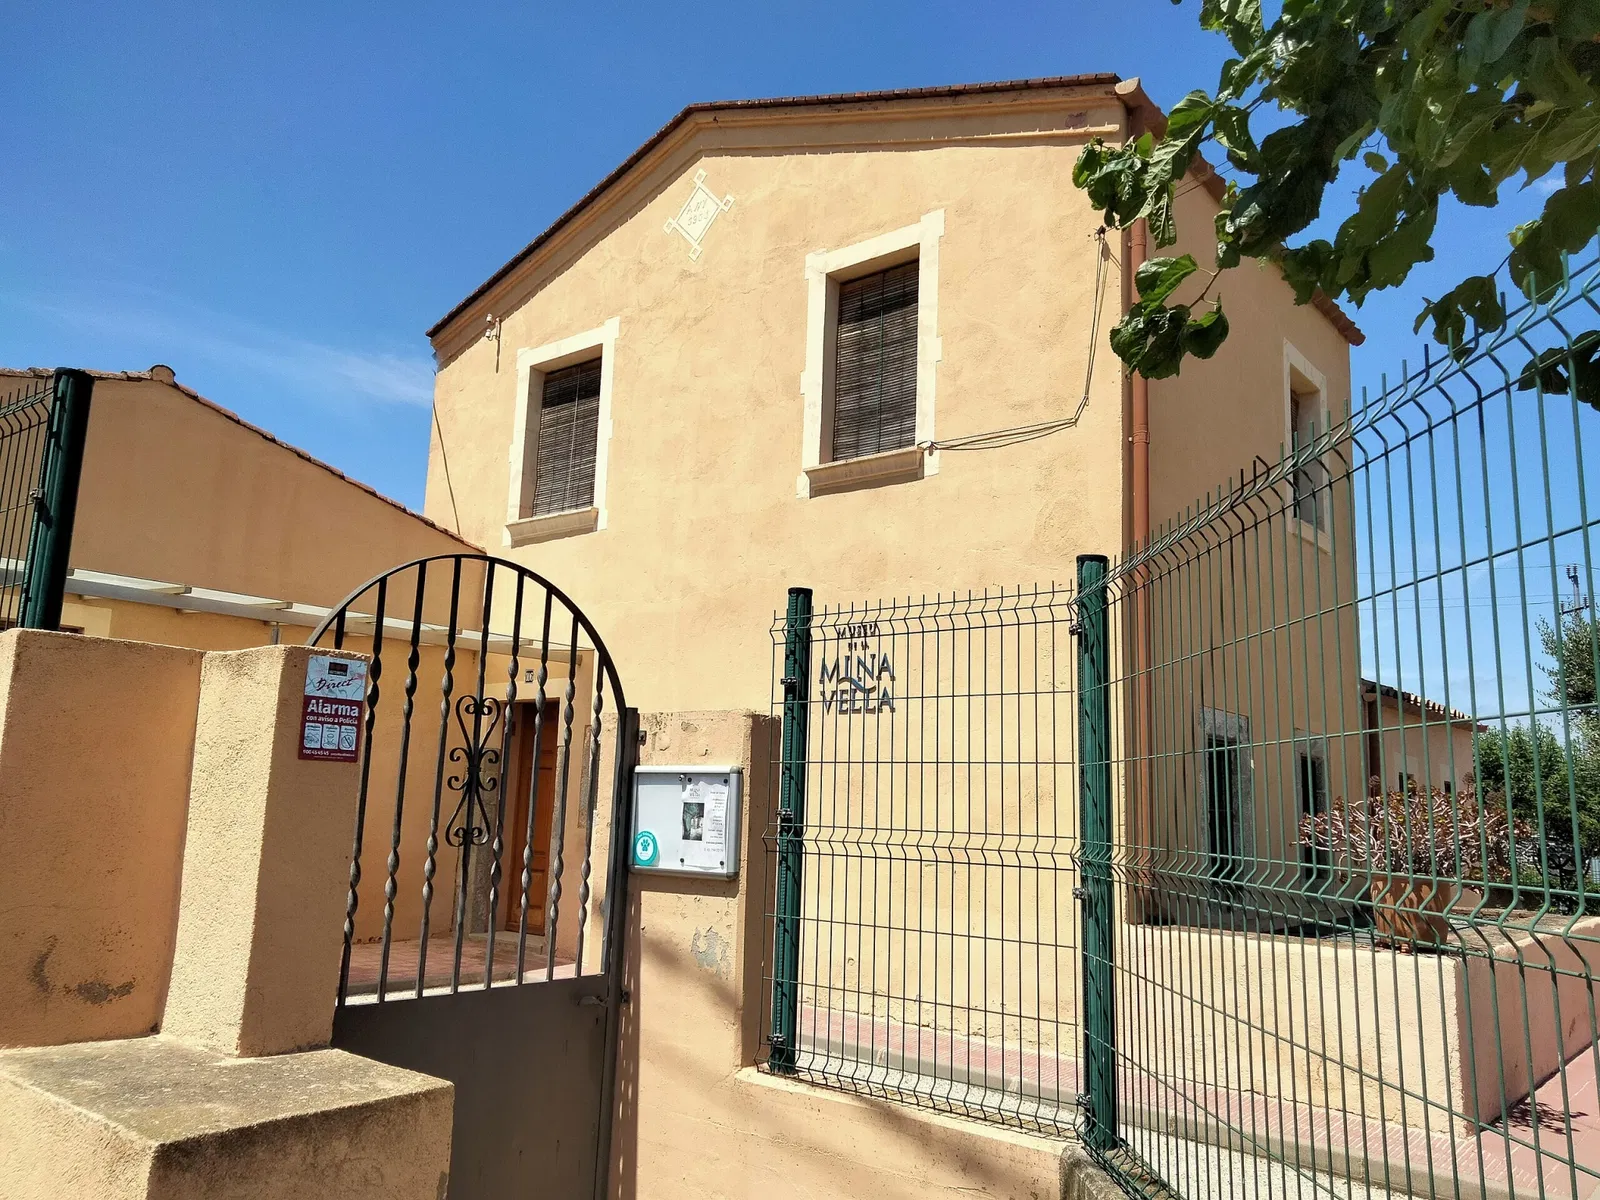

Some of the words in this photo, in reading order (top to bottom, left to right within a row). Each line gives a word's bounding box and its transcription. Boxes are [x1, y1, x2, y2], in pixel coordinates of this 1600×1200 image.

[819, 653, 896, 683] MINA
[316, 677, 359, 691] Direct
[307, 699, 359, 717] Alarma
[820, 687, 896, 715] VELLA
[318, 715, 334, 723] aviso
